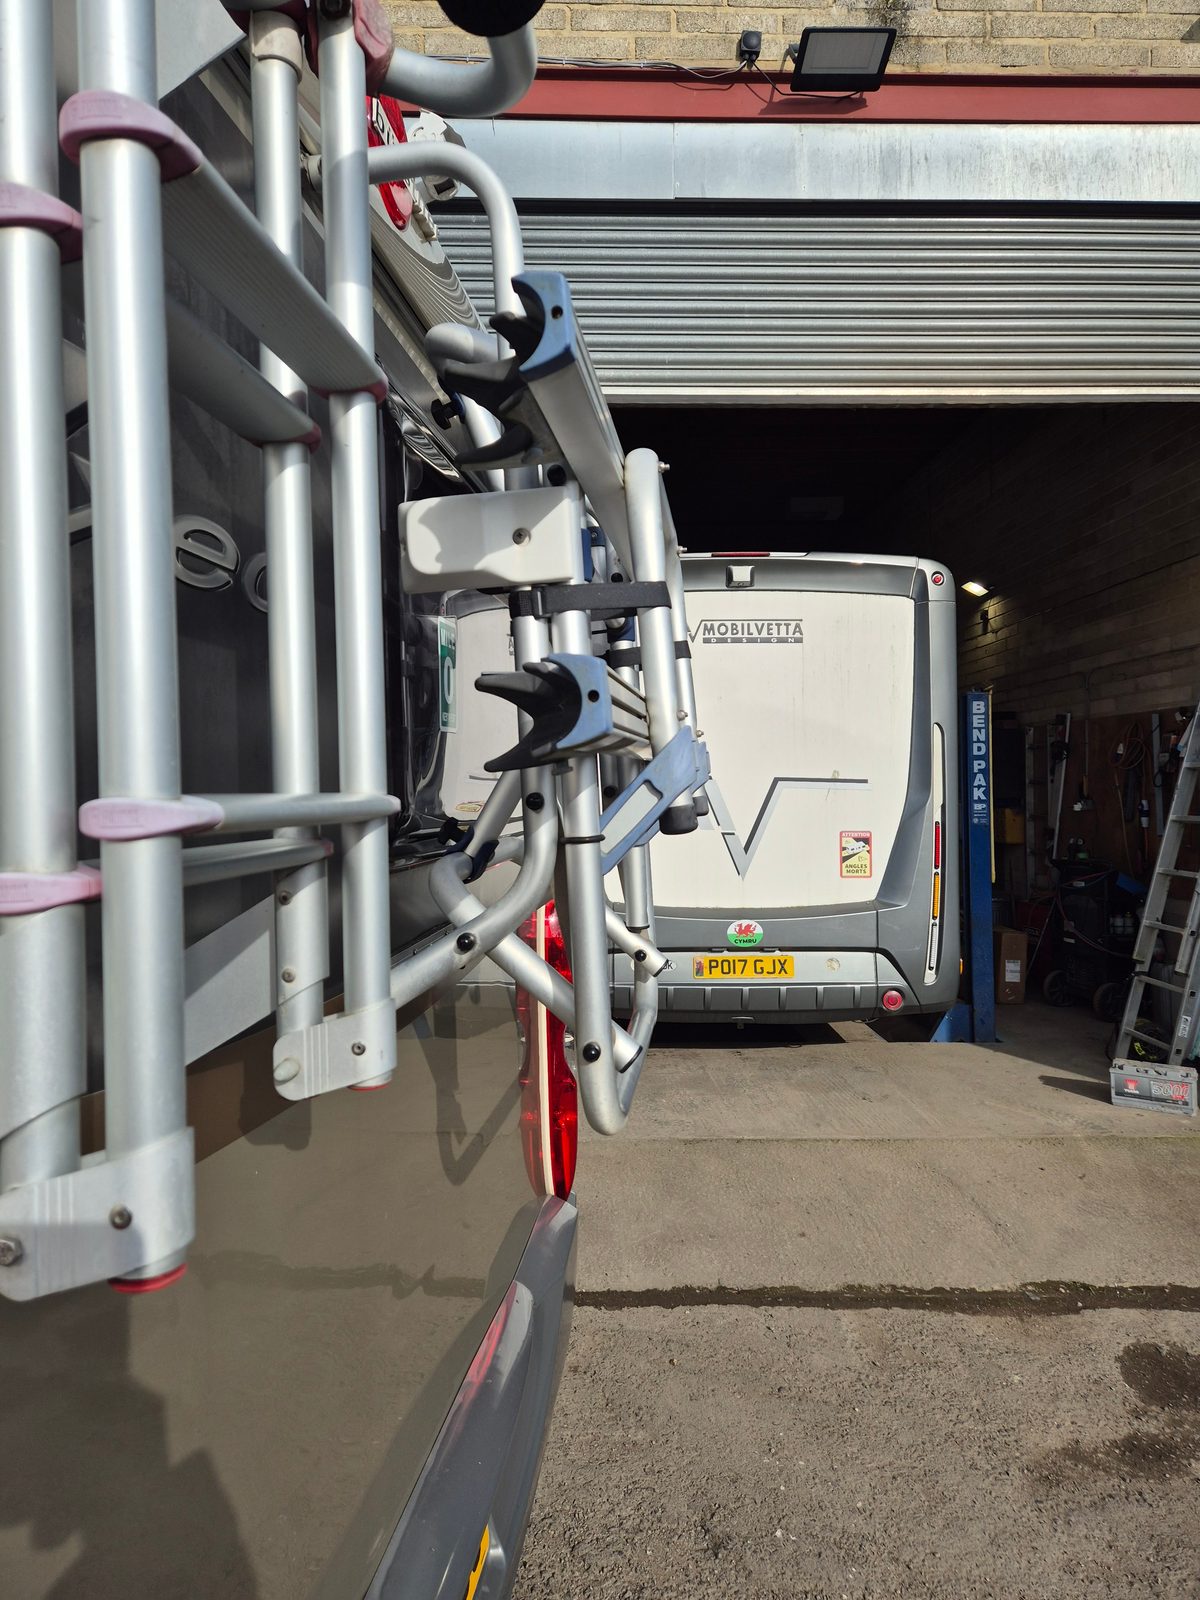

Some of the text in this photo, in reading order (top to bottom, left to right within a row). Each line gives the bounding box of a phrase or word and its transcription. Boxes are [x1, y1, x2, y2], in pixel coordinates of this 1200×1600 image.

[703, 622, 803, 636] MOBILVETTA
[972, 701, 986, 755] BEND
[973, 760, 987, 800] PAK
[708, 959, 788, 975] PO17 GJX
